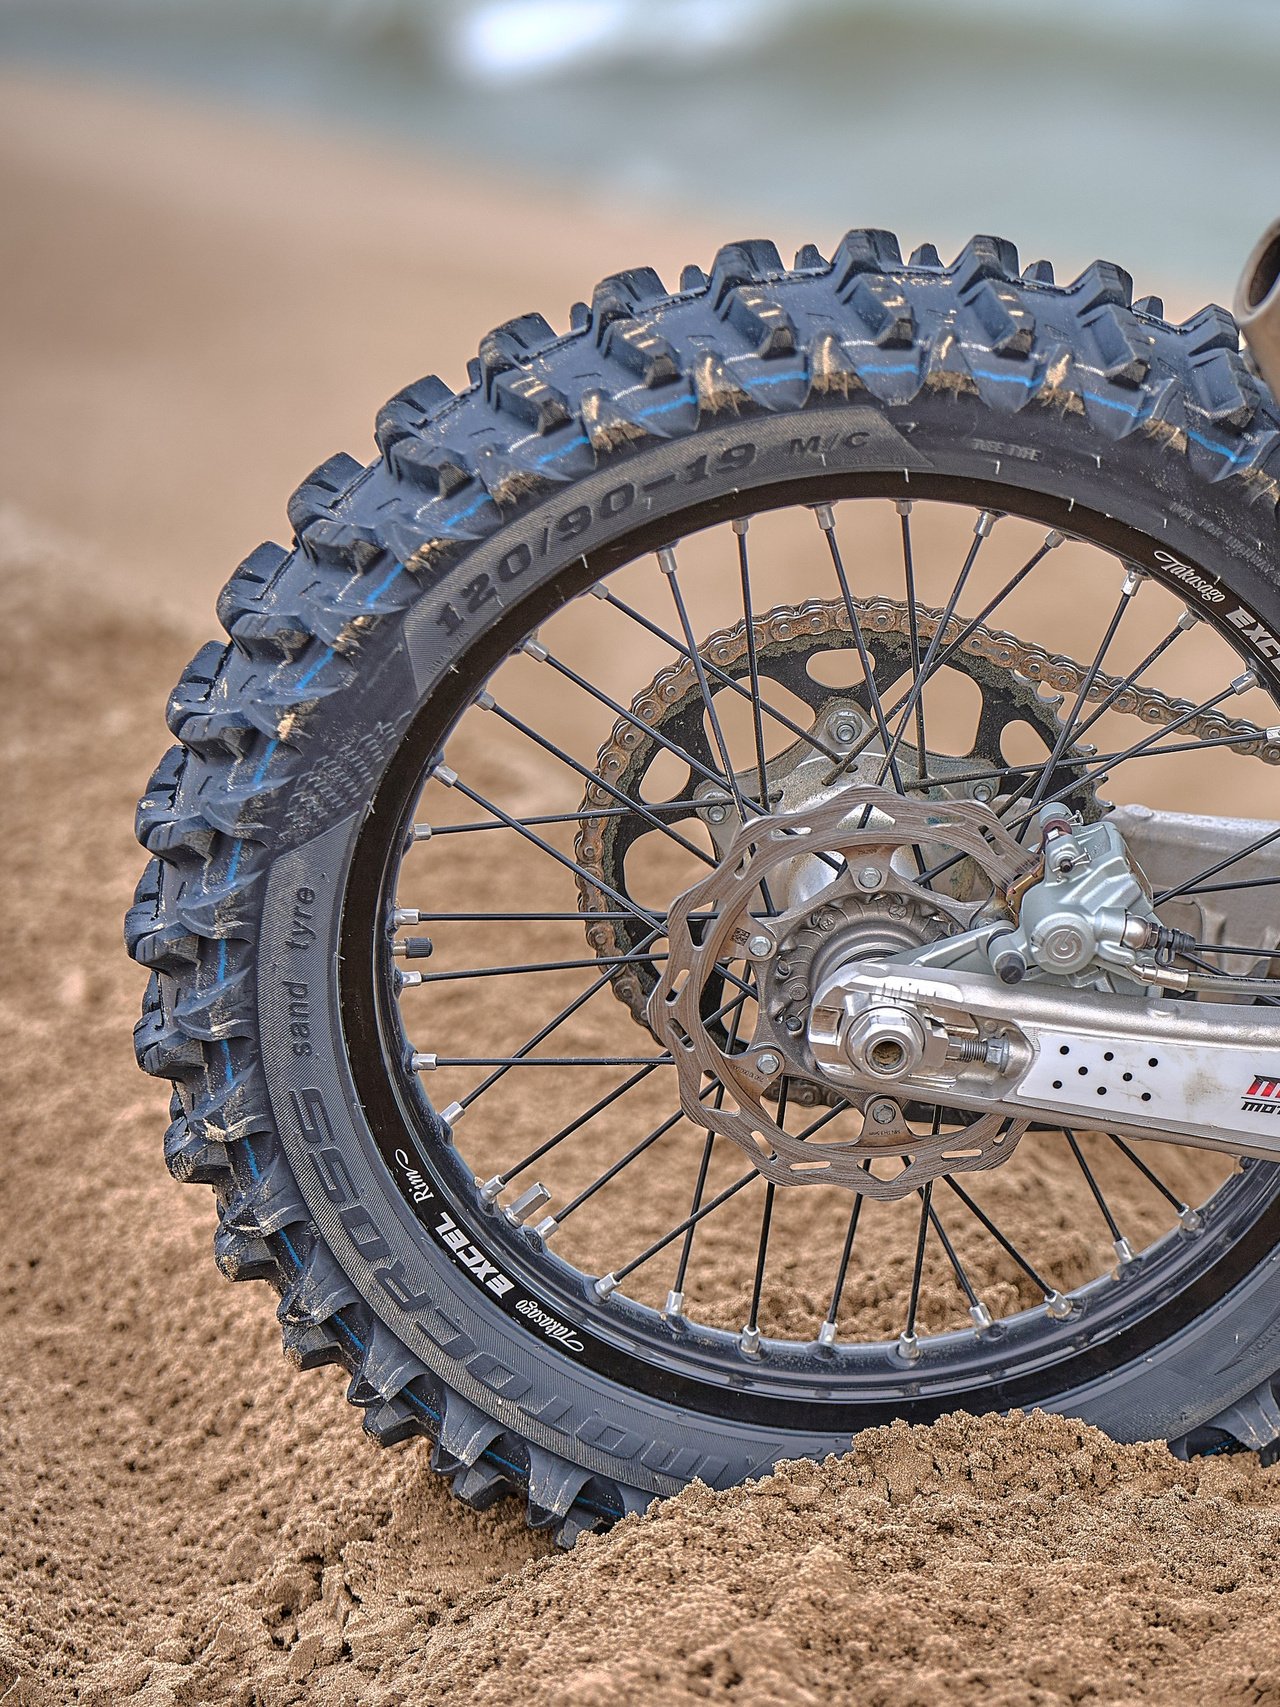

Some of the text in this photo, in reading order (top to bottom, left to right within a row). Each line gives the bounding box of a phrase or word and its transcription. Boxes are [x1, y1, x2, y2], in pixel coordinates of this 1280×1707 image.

[435, 430, 871, 637] 120/90-19 M/C
[1153, 549, 1226, 604] Takasago
[289, 886, 317, 1058] sand tyre
[290, 1086, 730, 1486] MOTOCROSS
[393, 1147, 585, 1353] Takasago EXCEL Rim
